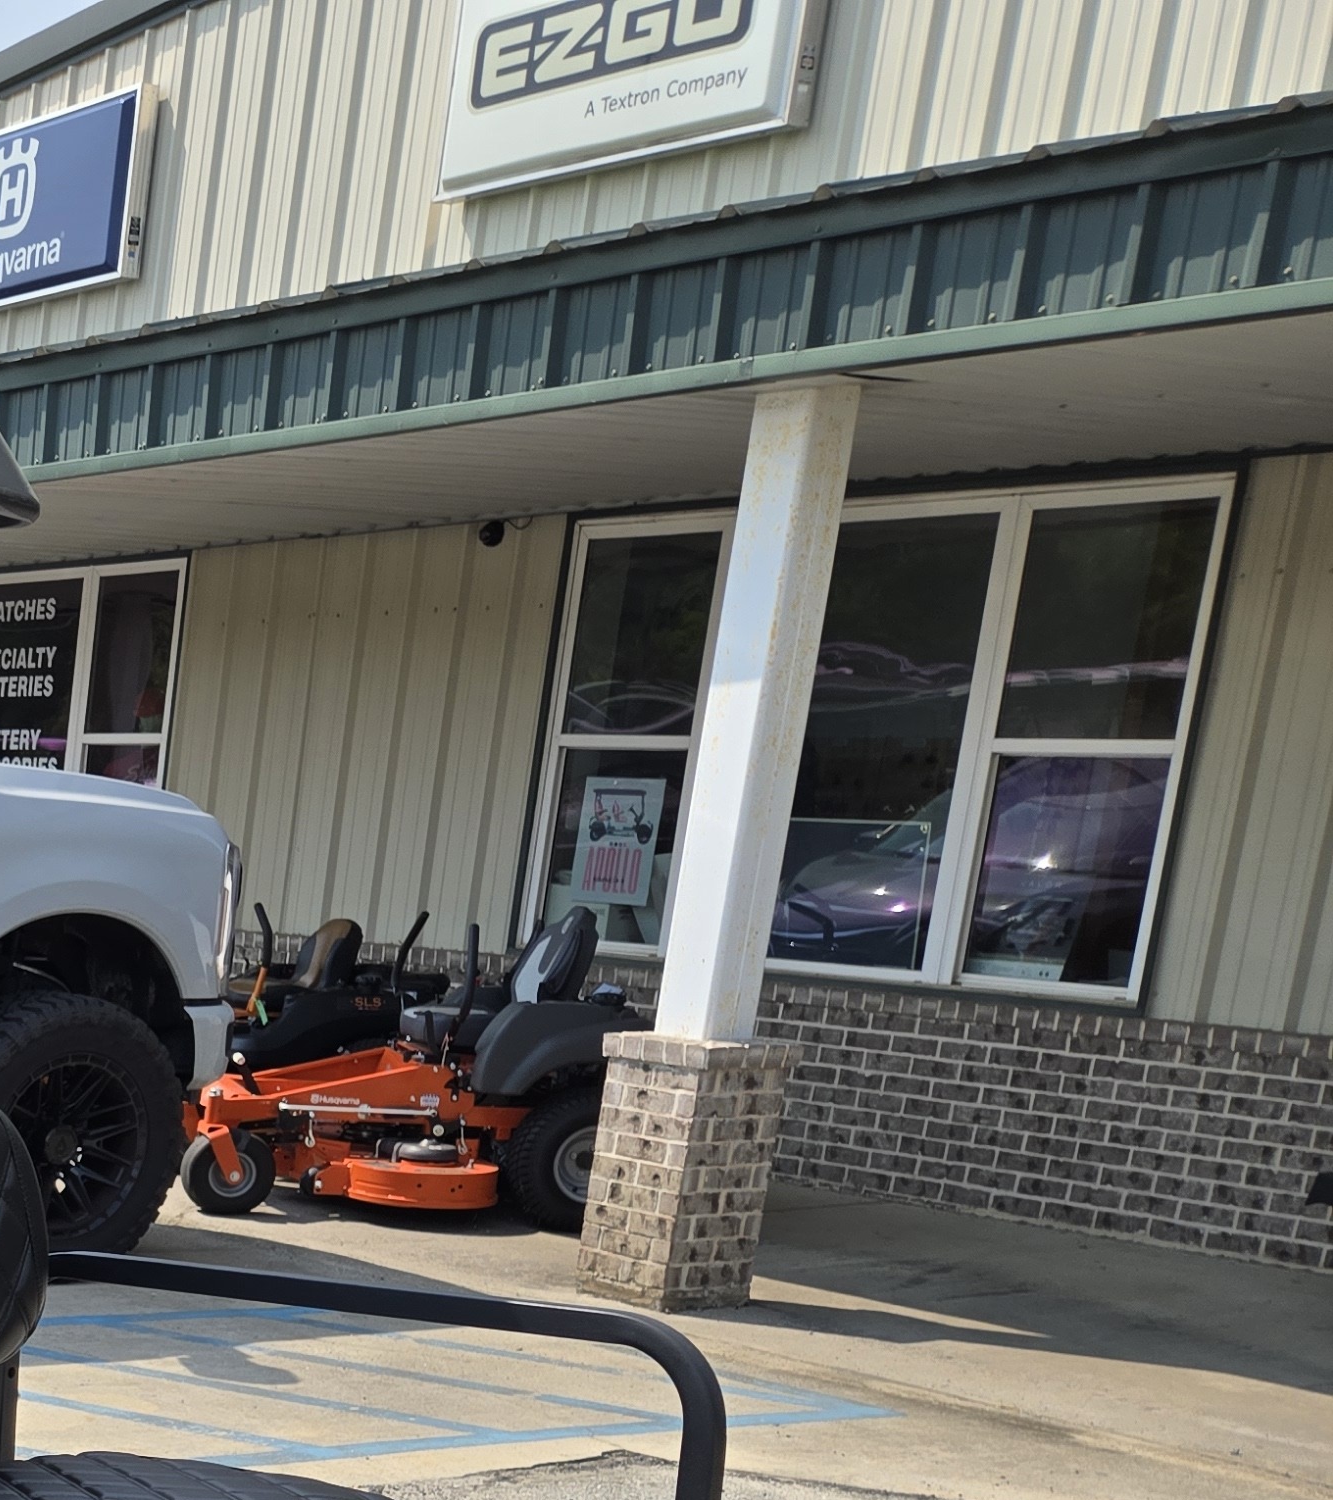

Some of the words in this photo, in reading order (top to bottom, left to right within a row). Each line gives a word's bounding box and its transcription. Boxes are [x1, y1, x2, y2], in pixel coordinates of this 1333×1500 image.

[480, 0, 742, 98] EZGO
[584, 100, 595, 118] A
[602, 86, 660, 115] Textron
[666, 67, 748, 99] Company
[582, 846, 642, 895] APOLLO
[355, 996, 382, 1007] SLS
[319, 1094, 360, 1106] Husqvarna
